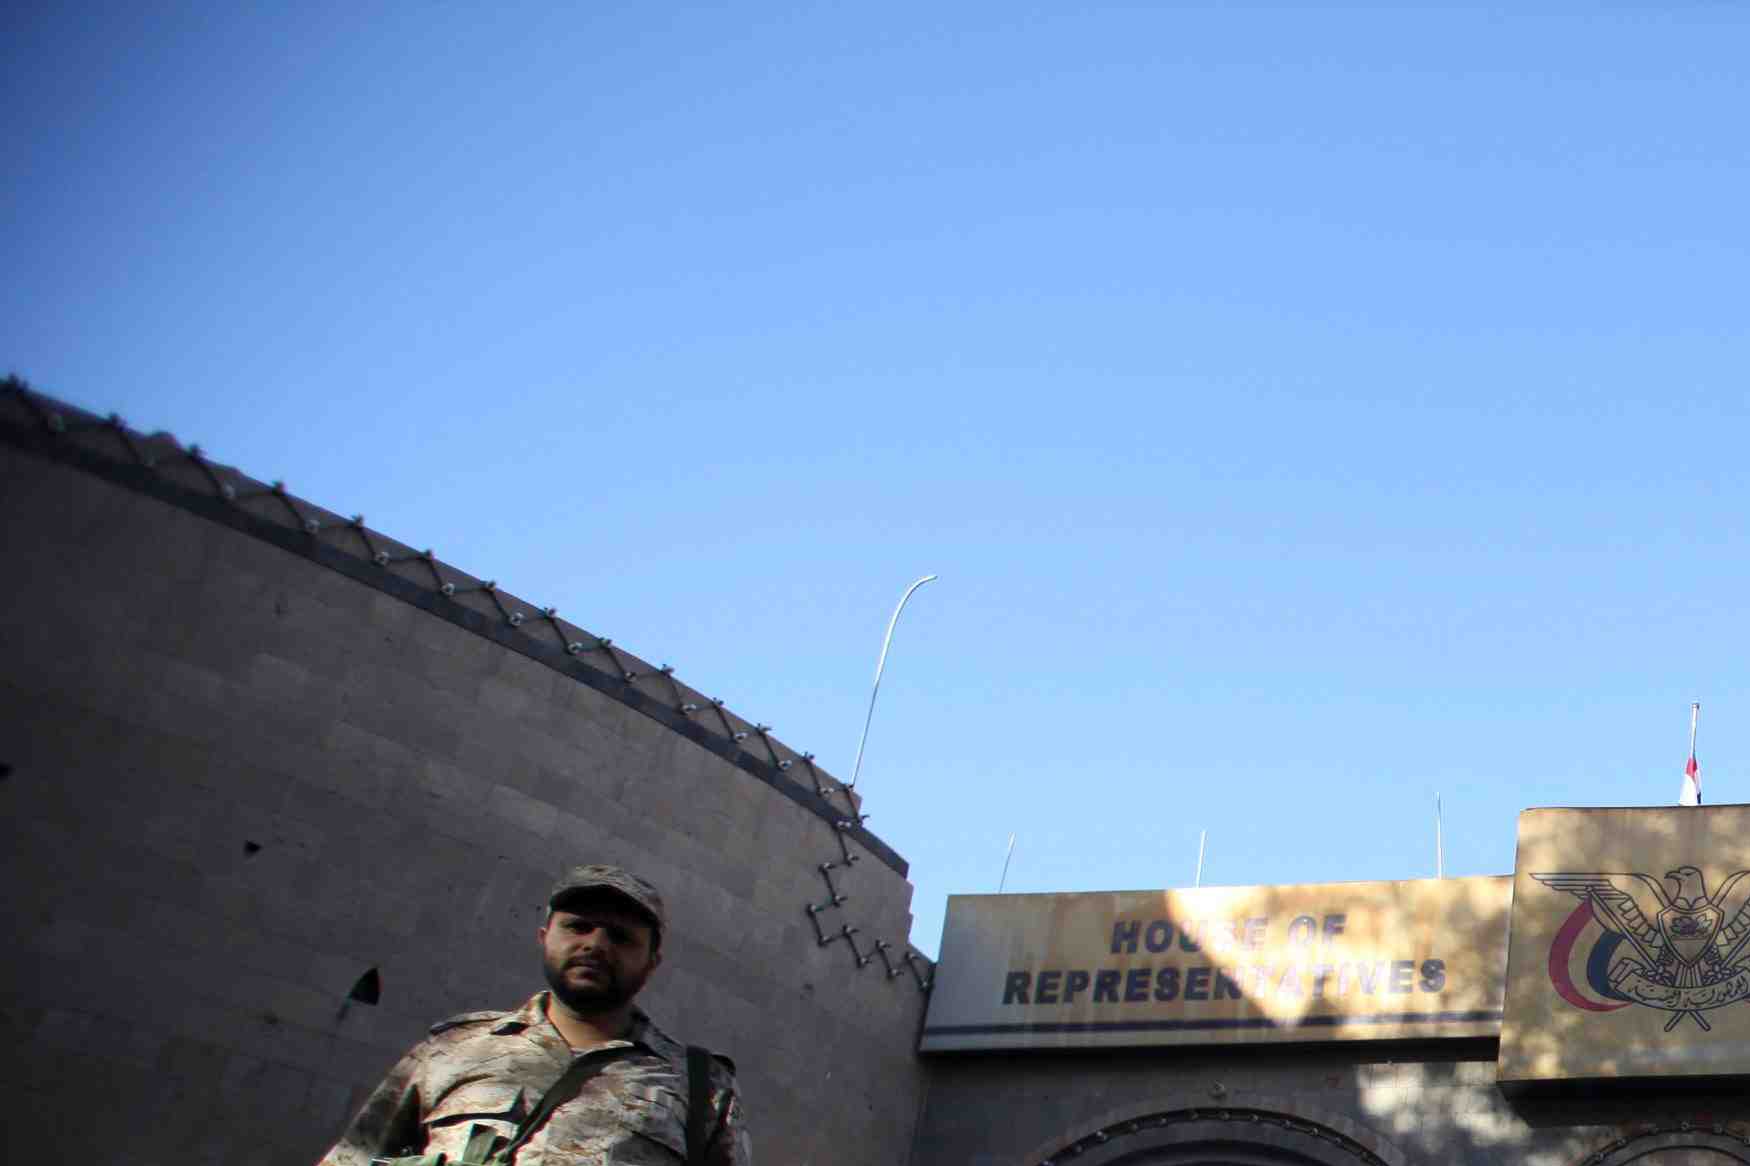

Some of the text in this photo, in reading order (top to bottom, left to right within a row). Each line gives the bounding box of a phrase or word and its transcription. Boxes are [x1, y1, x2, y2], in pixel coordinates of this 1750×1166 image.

[1110, 912, 1347, 954] HOUE OF
[1002, 957, 1447, 1005] REPRESENTATIVES
